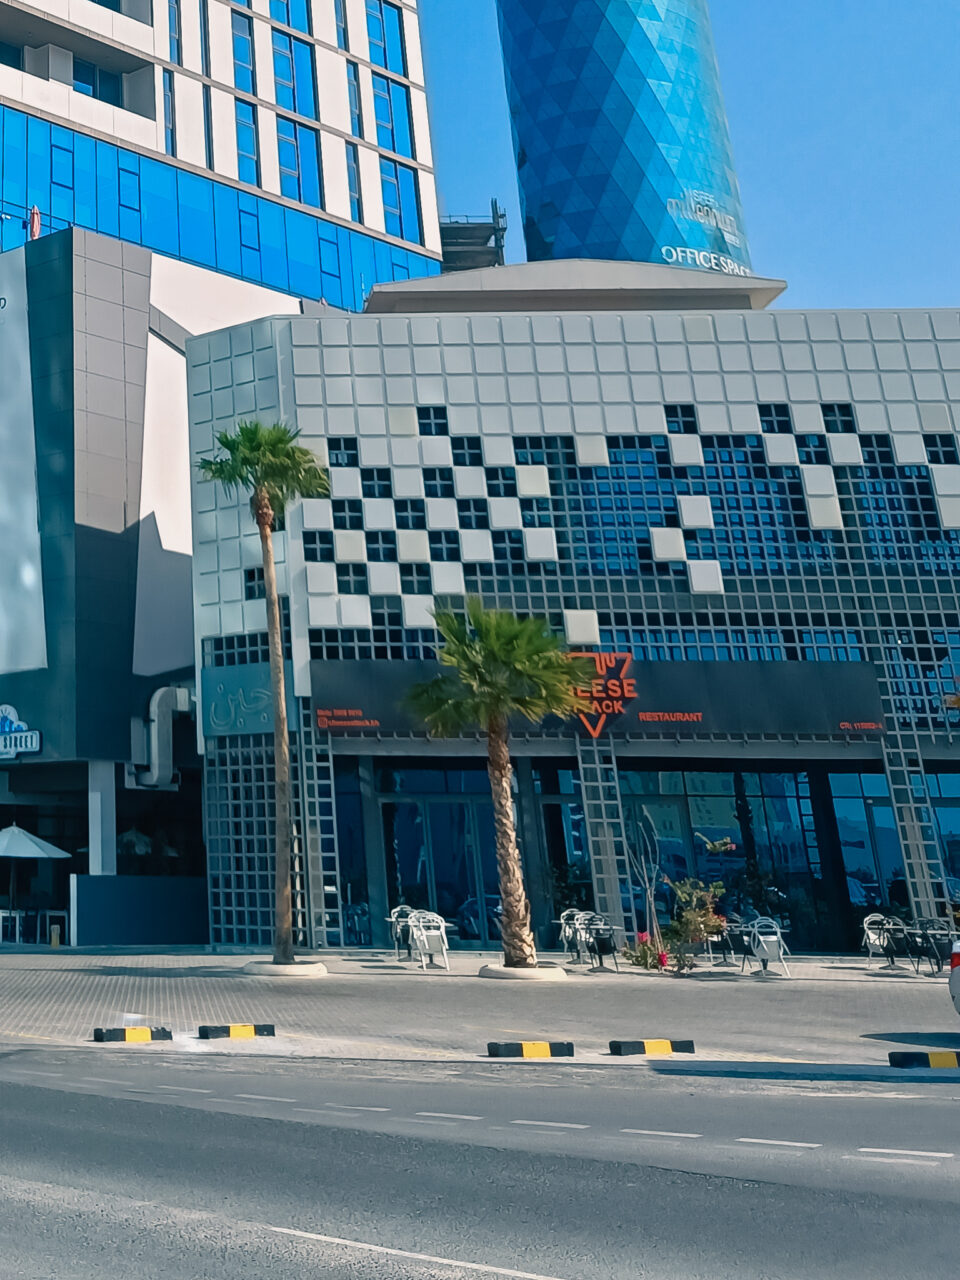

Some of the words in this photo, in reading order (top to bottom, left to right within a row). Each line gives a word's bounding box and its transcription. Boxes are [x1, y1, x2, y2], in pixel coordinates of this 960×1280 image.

[661, 246, 720, 270] OFFICE
[638, 712, 703, 722] RESTAURANT
[3, 734, 34, 750] STREET
